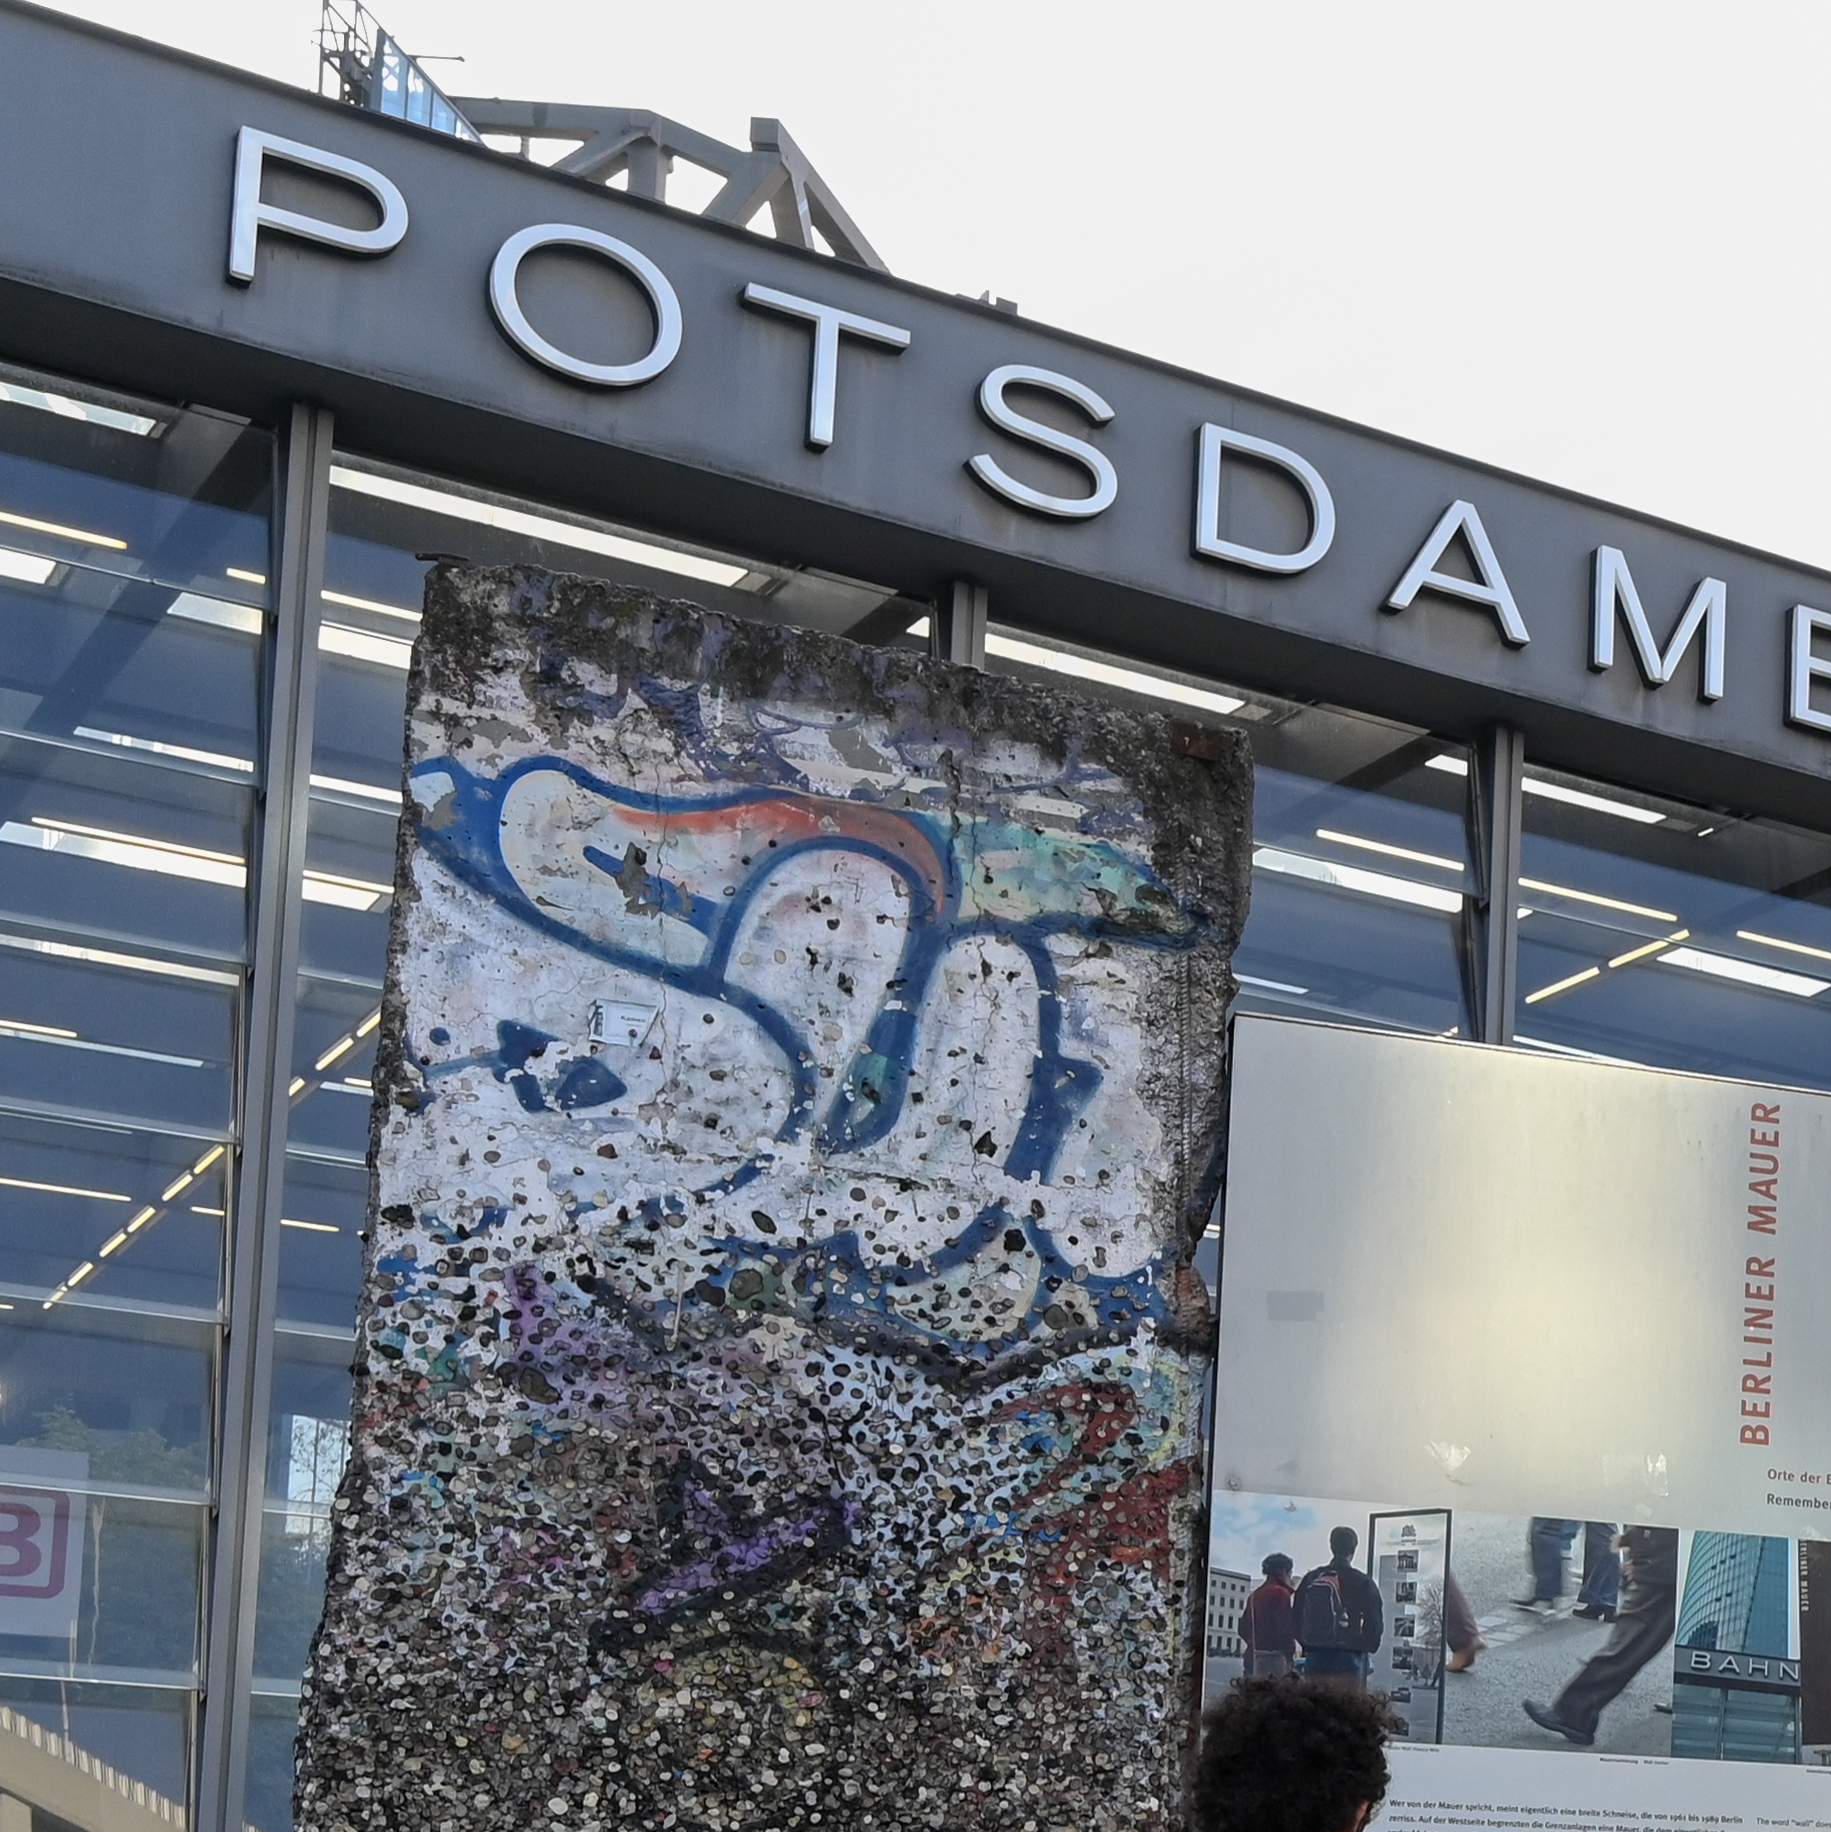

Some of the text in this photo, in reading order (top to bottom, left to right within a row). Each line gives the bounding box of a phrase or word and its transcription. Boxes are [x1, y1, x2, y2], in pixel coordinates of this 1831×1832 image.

[1740, 1103, 1780, 1446] BERLINER MAUER
[1767, 1468, 1794, 1481] Orte
[1800, 1471, 1821, 1483] der
